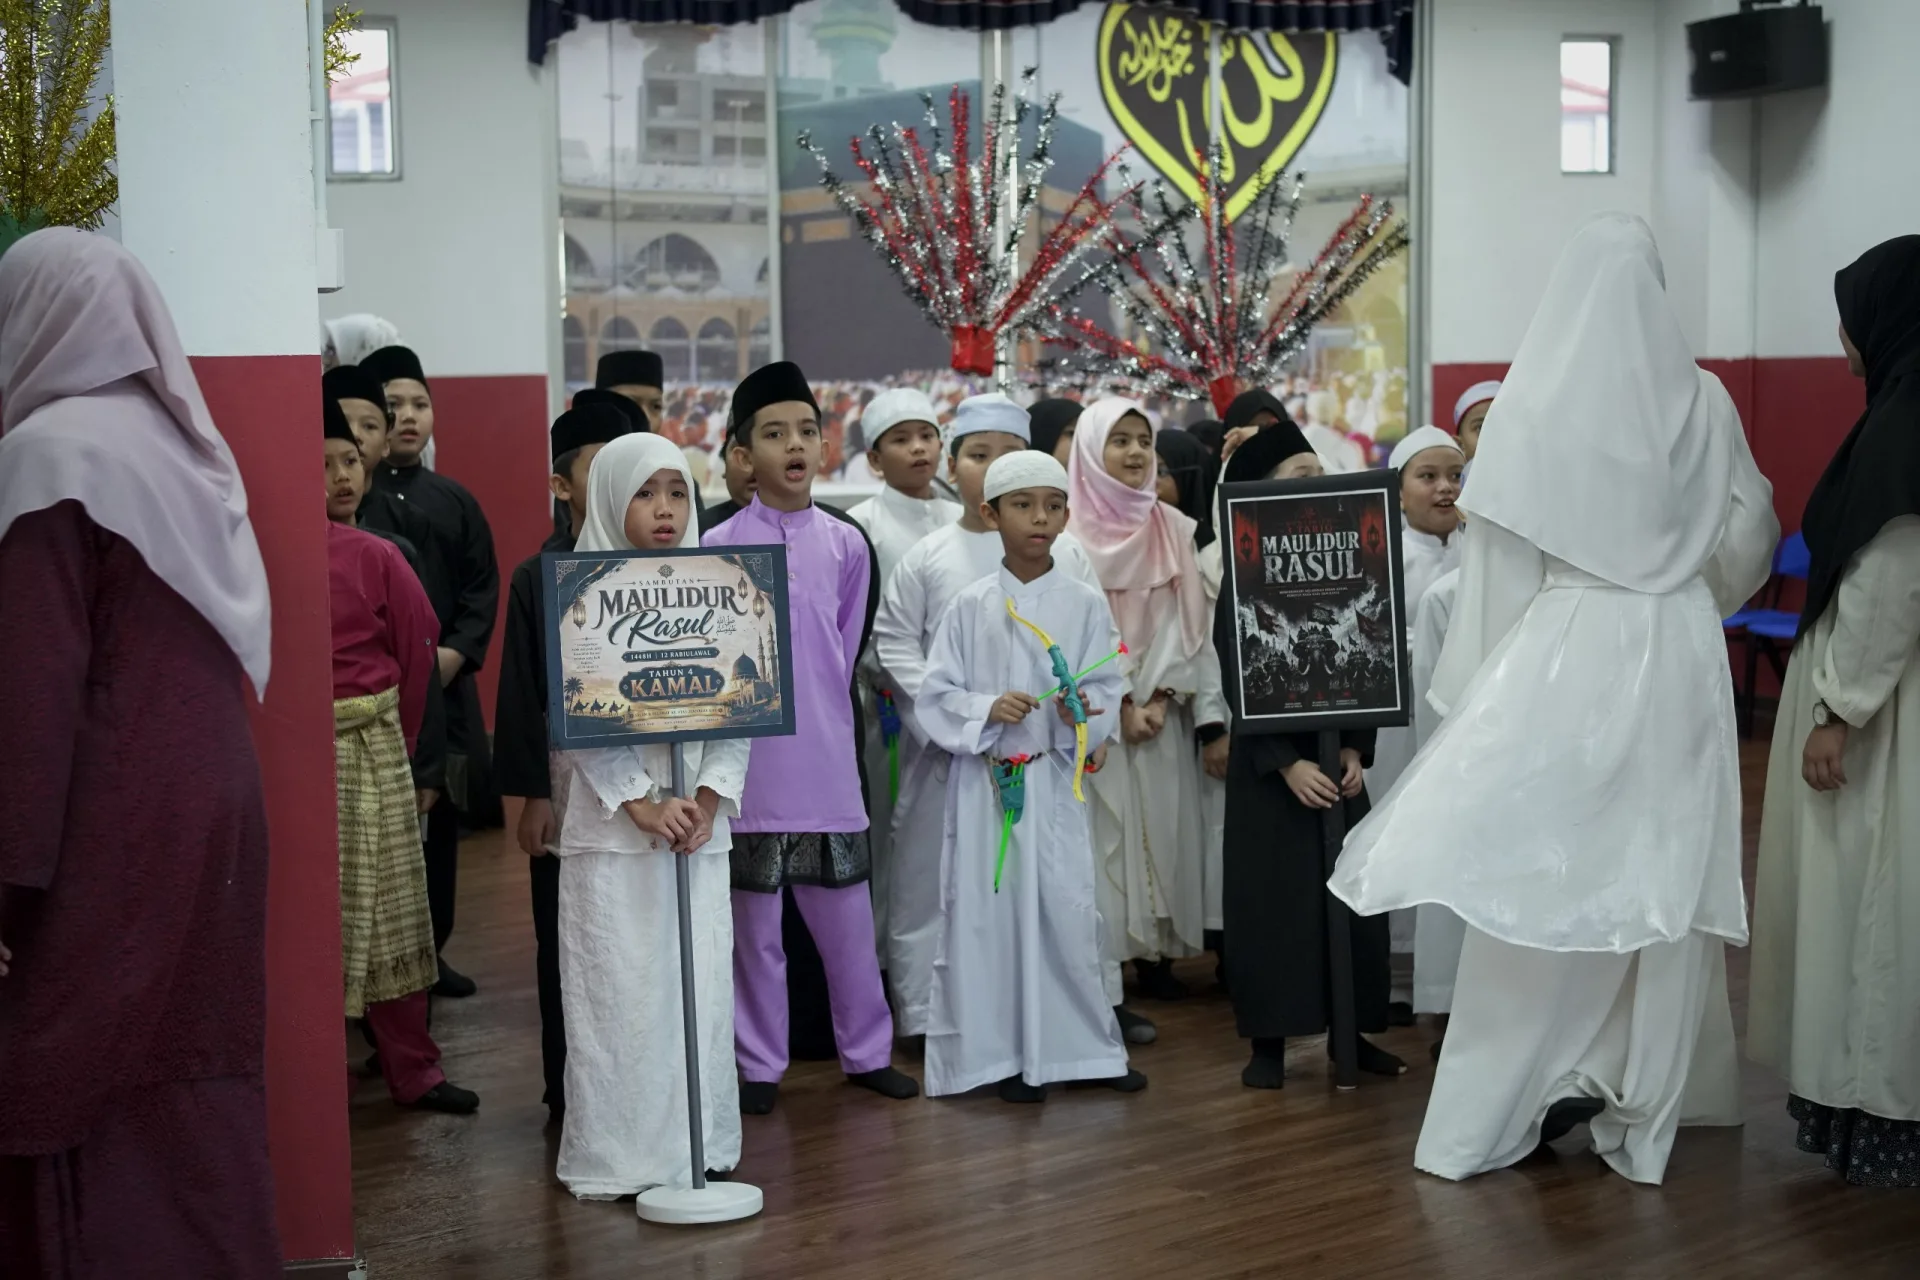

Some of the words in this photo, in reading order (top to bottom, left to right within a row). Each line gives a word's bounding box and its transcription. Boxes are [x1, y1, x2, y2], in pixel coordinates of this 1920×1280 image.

[1262, 531, 1360, 555] MAULIDUR
[1263, 549, 1364, 584] RASUL
[639, 578, 695, 586] SAMBUTAN
[591, 586, 748, 629] MAULIDUR
[608, 609, 718, 649] Rasul
[670, 650, 711, 658] RABIULAWAL
[649, 669, 684, 678] TAHUN
[630, 675, 718, 698] KAMAL
